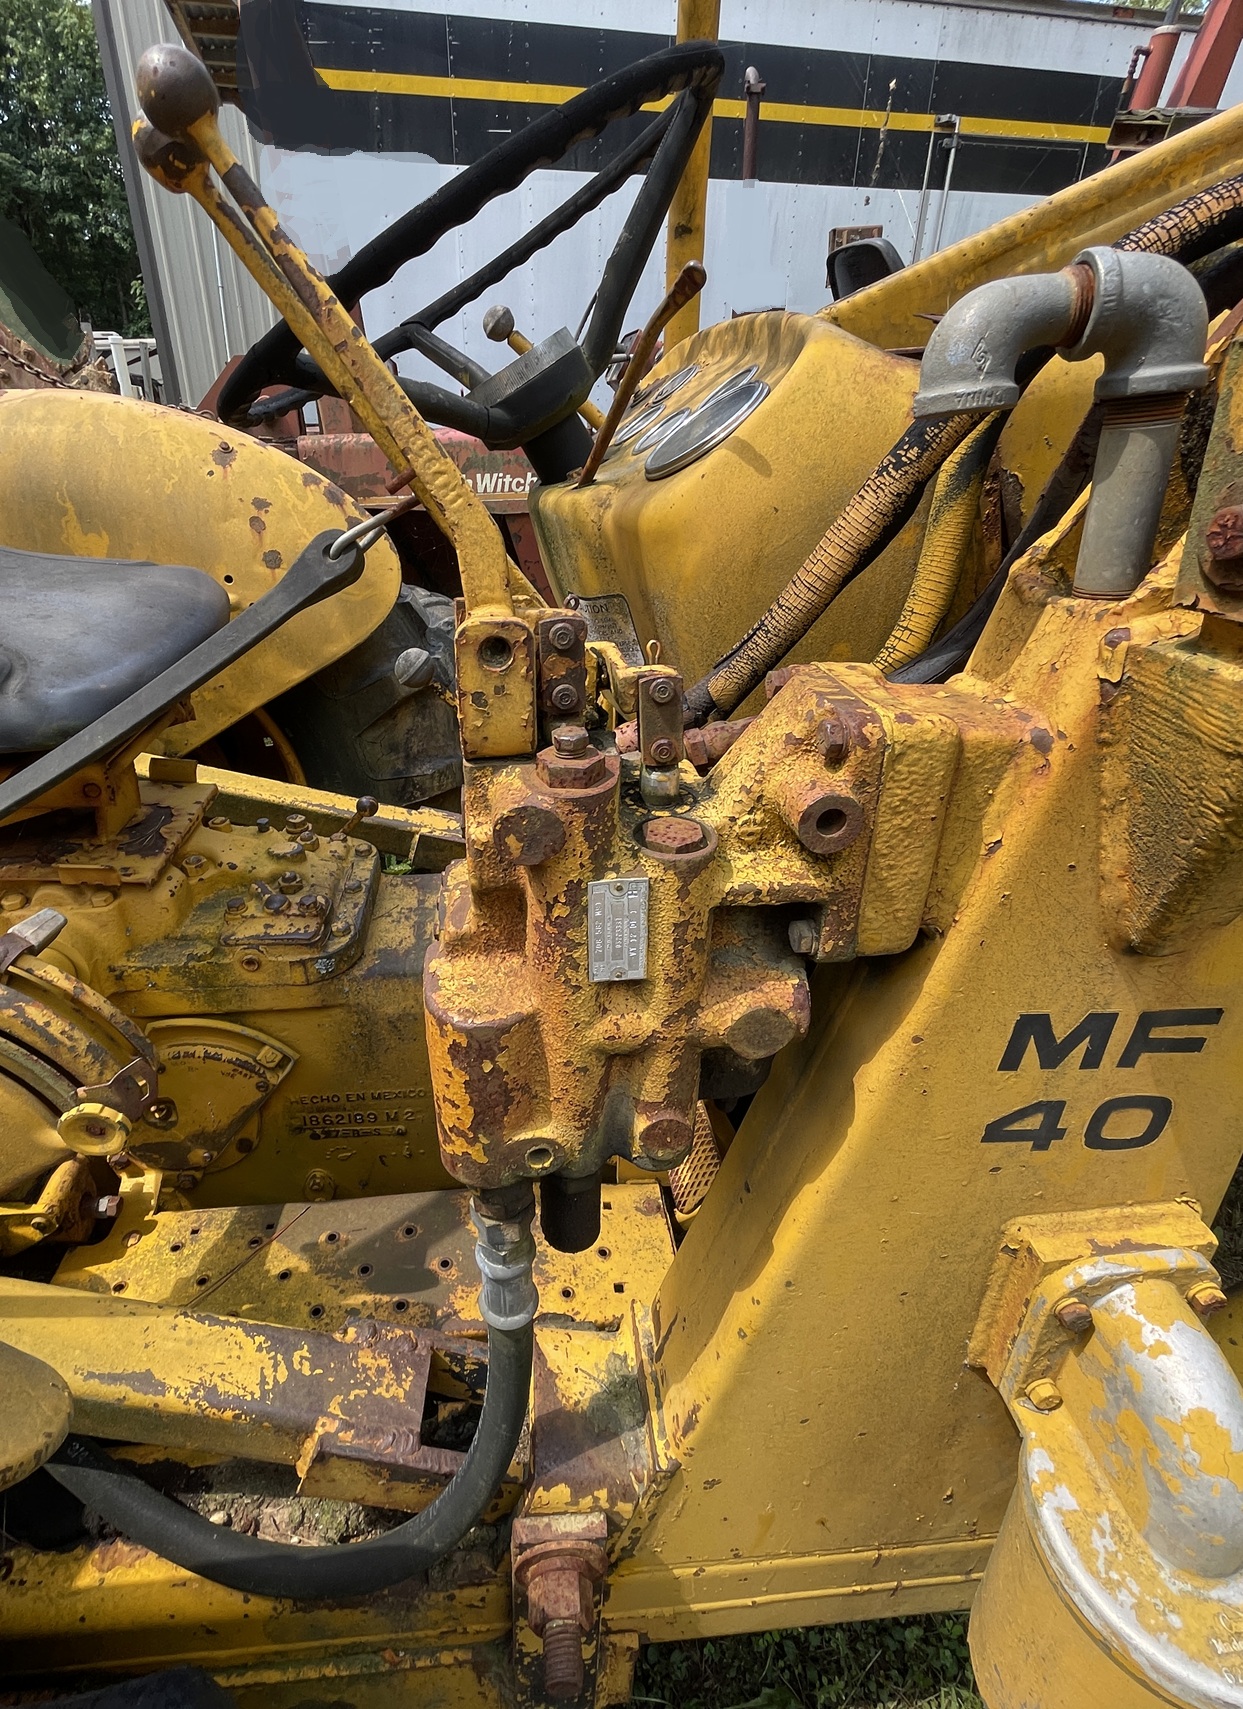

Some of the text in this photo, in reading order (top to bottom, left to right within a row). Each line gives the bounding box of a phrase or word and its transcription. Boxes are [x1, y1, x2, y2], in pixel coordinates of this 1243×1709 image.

[997, 1008, 1224, 1071] MF
[290, 1088, 426, 1105] HECHO EN MEXICO
[302, 1111, 378, 1126] 1862189
[980, 1095, 1174, 1151] 40
